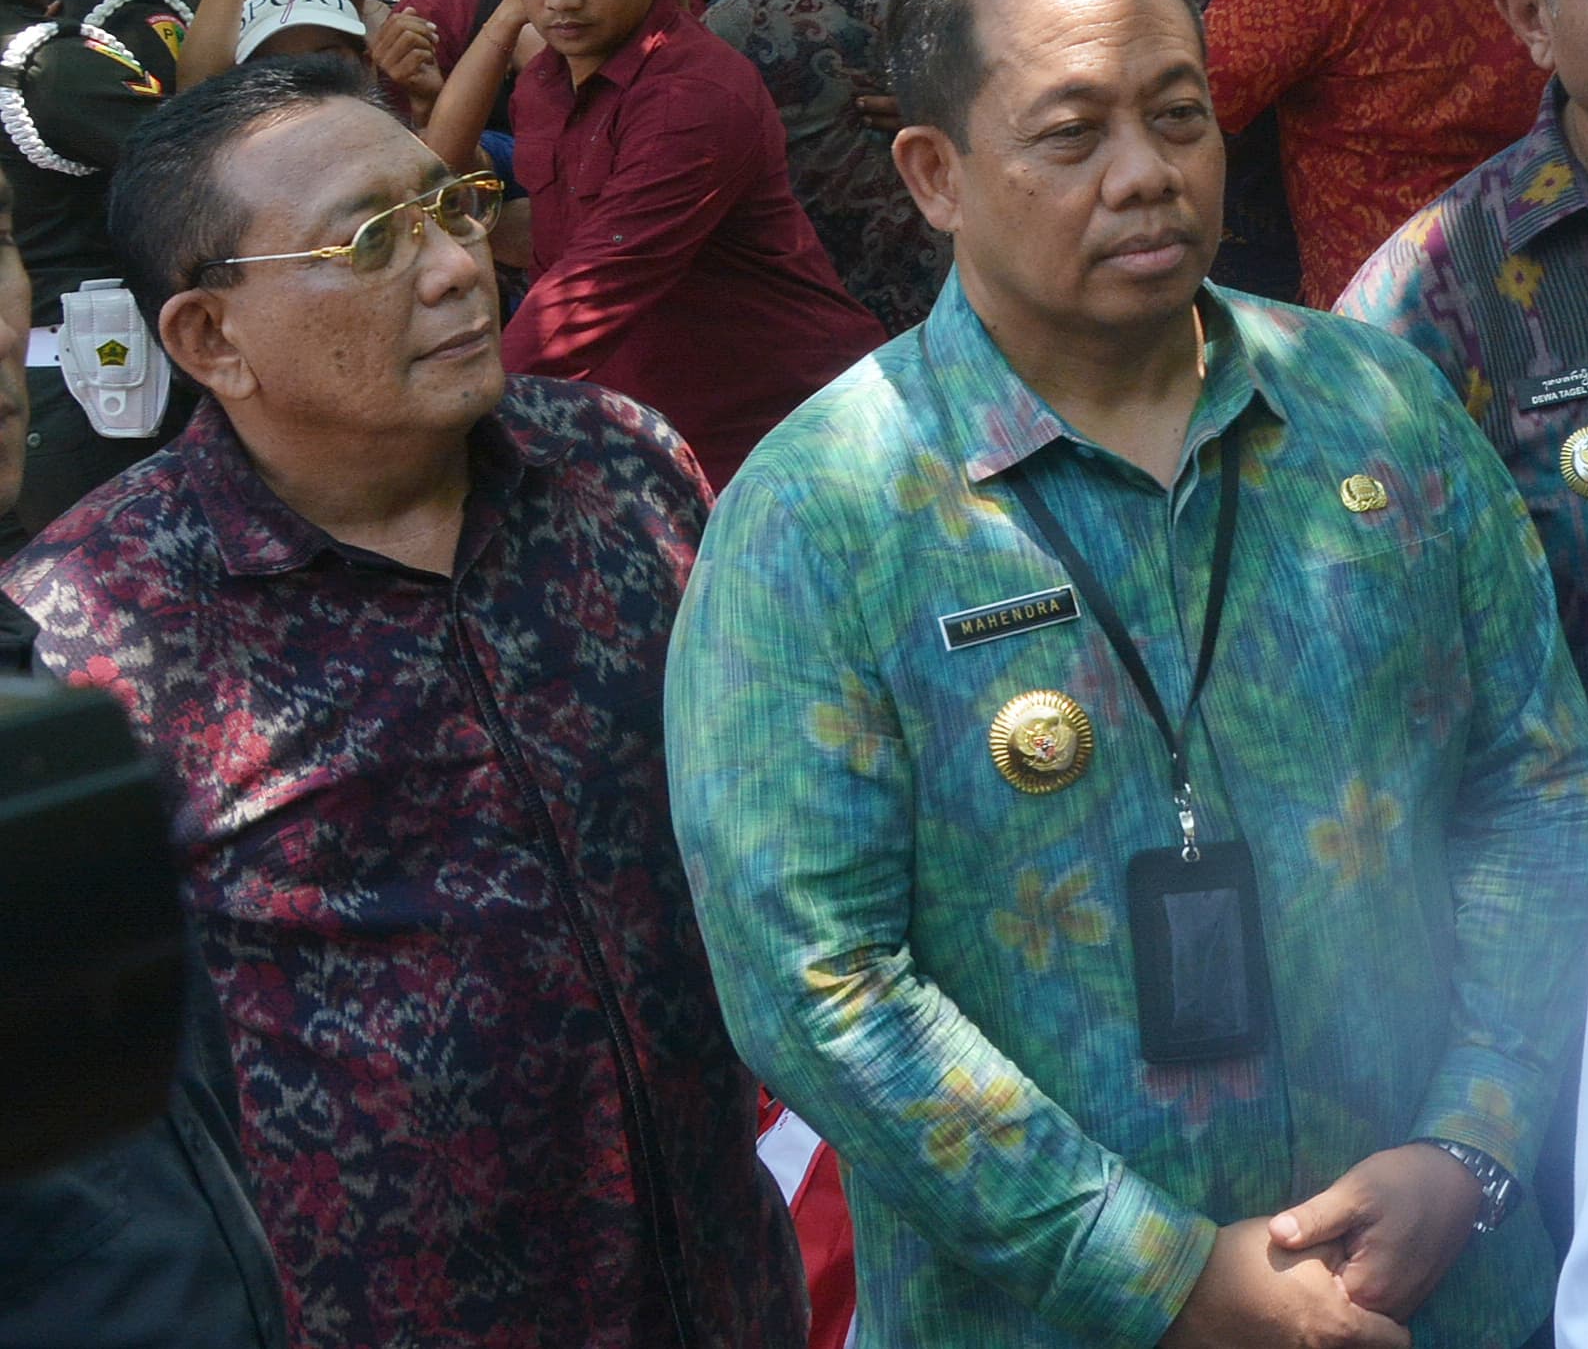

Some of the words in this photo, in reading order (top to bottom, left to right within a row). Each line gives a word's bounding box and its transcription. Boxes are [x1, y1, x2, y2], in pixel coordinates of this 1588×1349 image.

[1531, 392, 1558, 404] DEWA
[1559, 385, 1588, 398] TAGEL
[960, 598, 1062, 636] MAHENDRA
